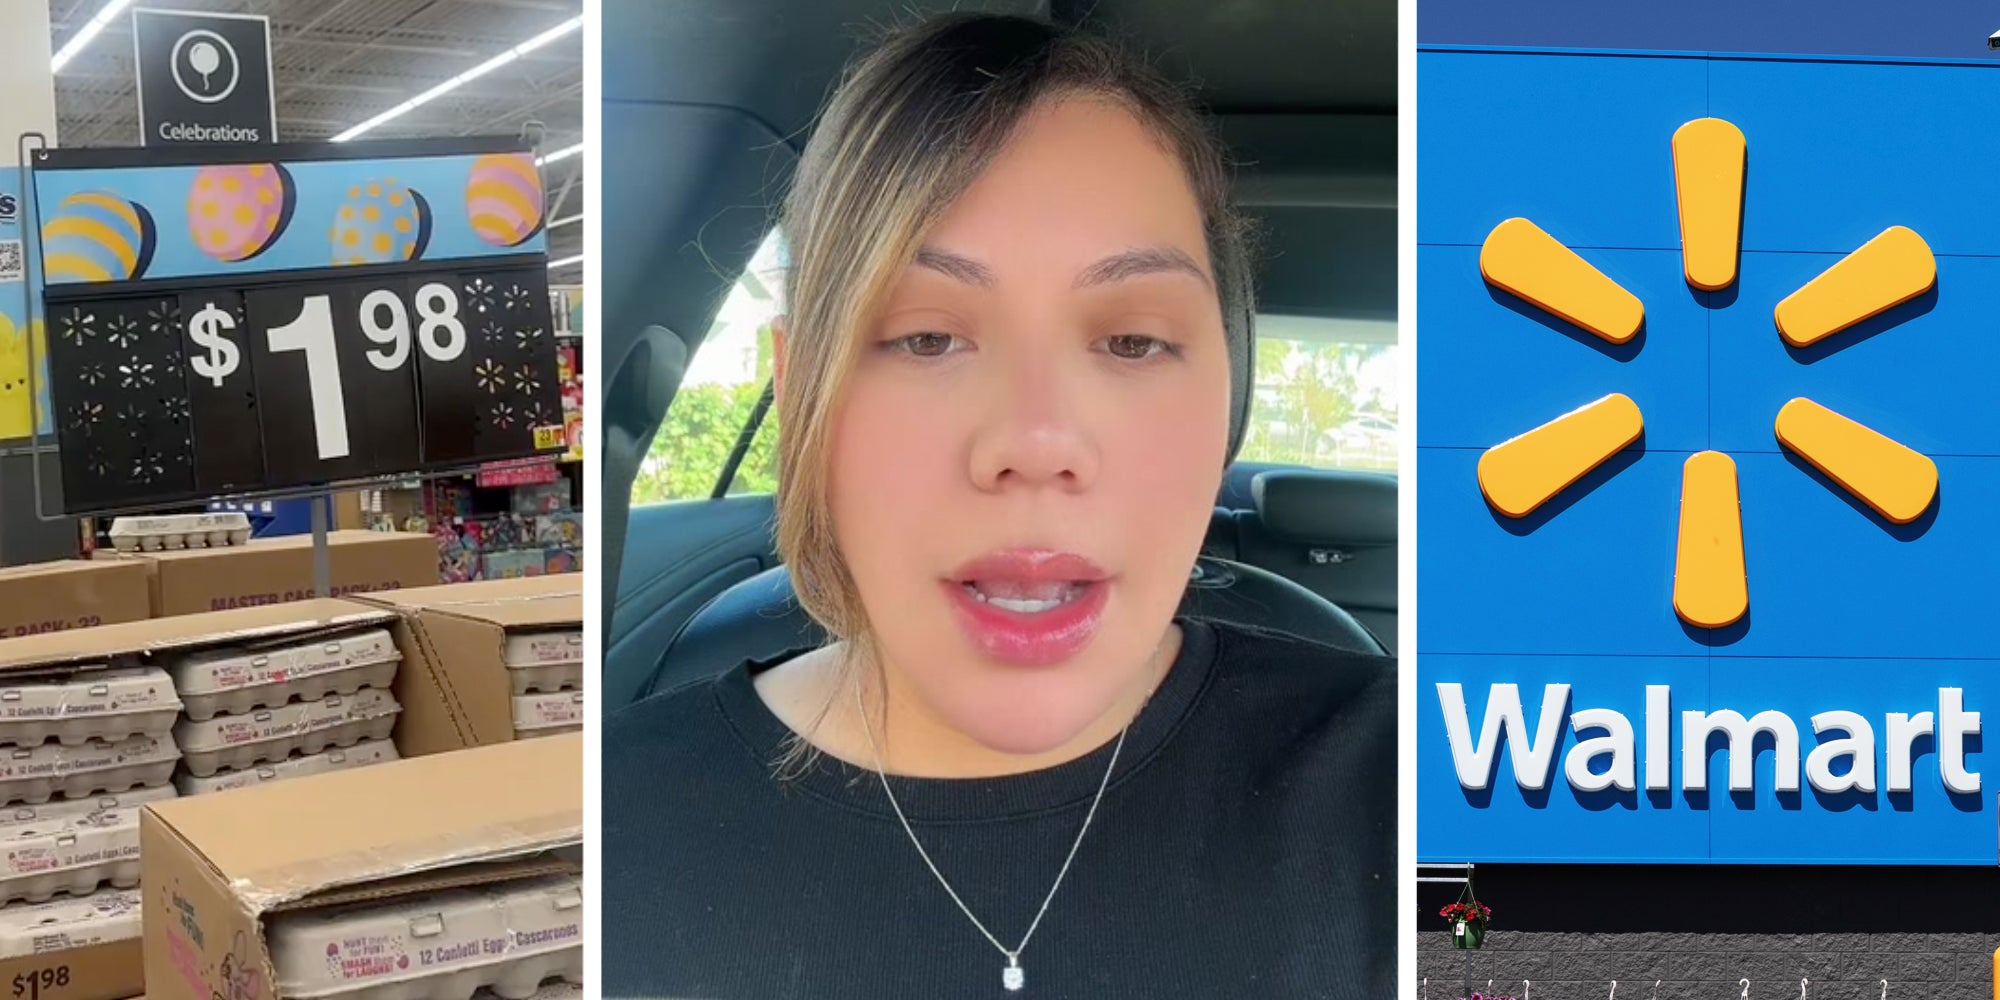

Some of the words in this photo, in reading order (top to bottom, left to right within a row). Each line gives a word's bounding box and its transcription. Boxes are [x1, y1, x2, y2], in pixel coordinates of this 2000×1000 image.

[159, 121, 259, 142] Celebrations
[1435, 682, 1982, 793] Walmart
[419, 949, 434, 966] 12
[436, 938, 480, 963] Confetti
[515, 923, 579, 947] Cascarones
